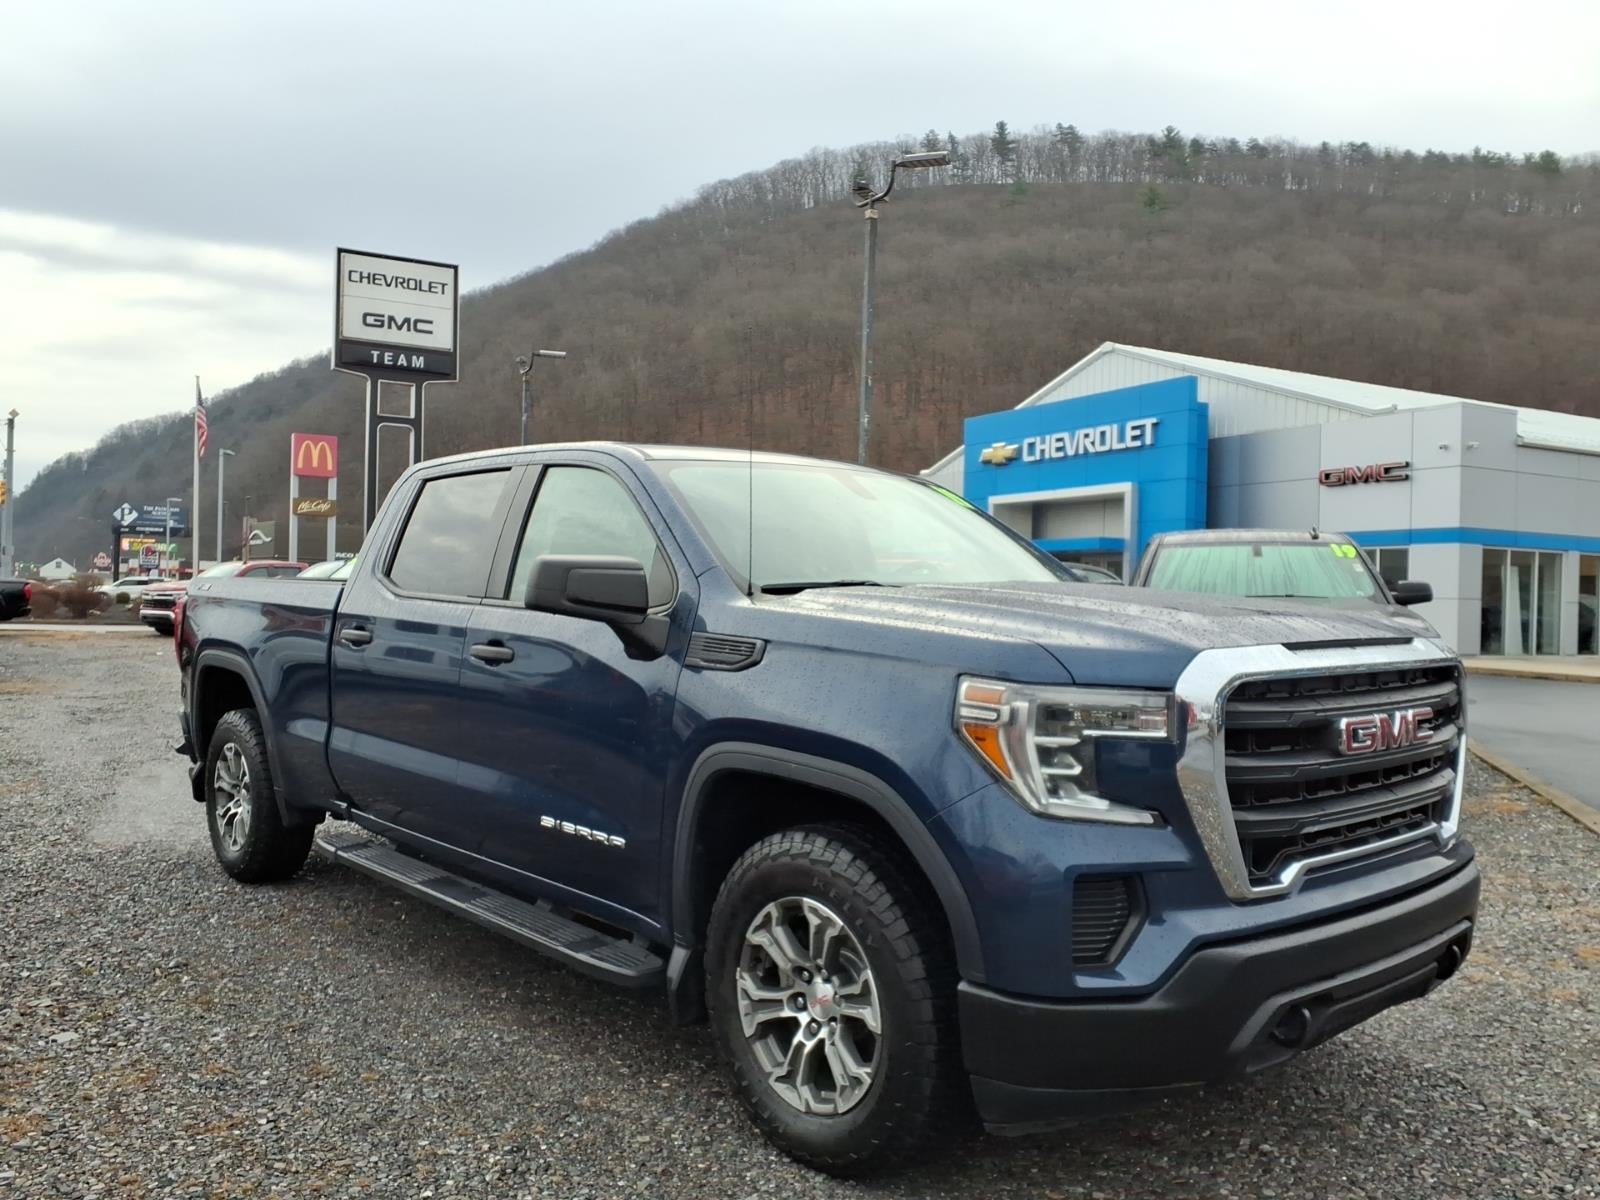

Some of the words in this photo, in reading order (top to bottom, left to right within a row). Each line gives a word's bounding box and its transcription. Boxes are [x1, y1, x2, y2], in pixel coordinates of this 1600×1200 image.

[348, 269, 448, 296] CHEVROLET
[362, 311, 434, 335] GMC
[371, 350, 425, 369] TEAM
[1022, 417, 1158, 463] CHEVROLET
[1319, 461, 1410, 487] GMC
[1340, 707, 1434, 754] GMC
[540, 815, 626, 849] SIERRA
